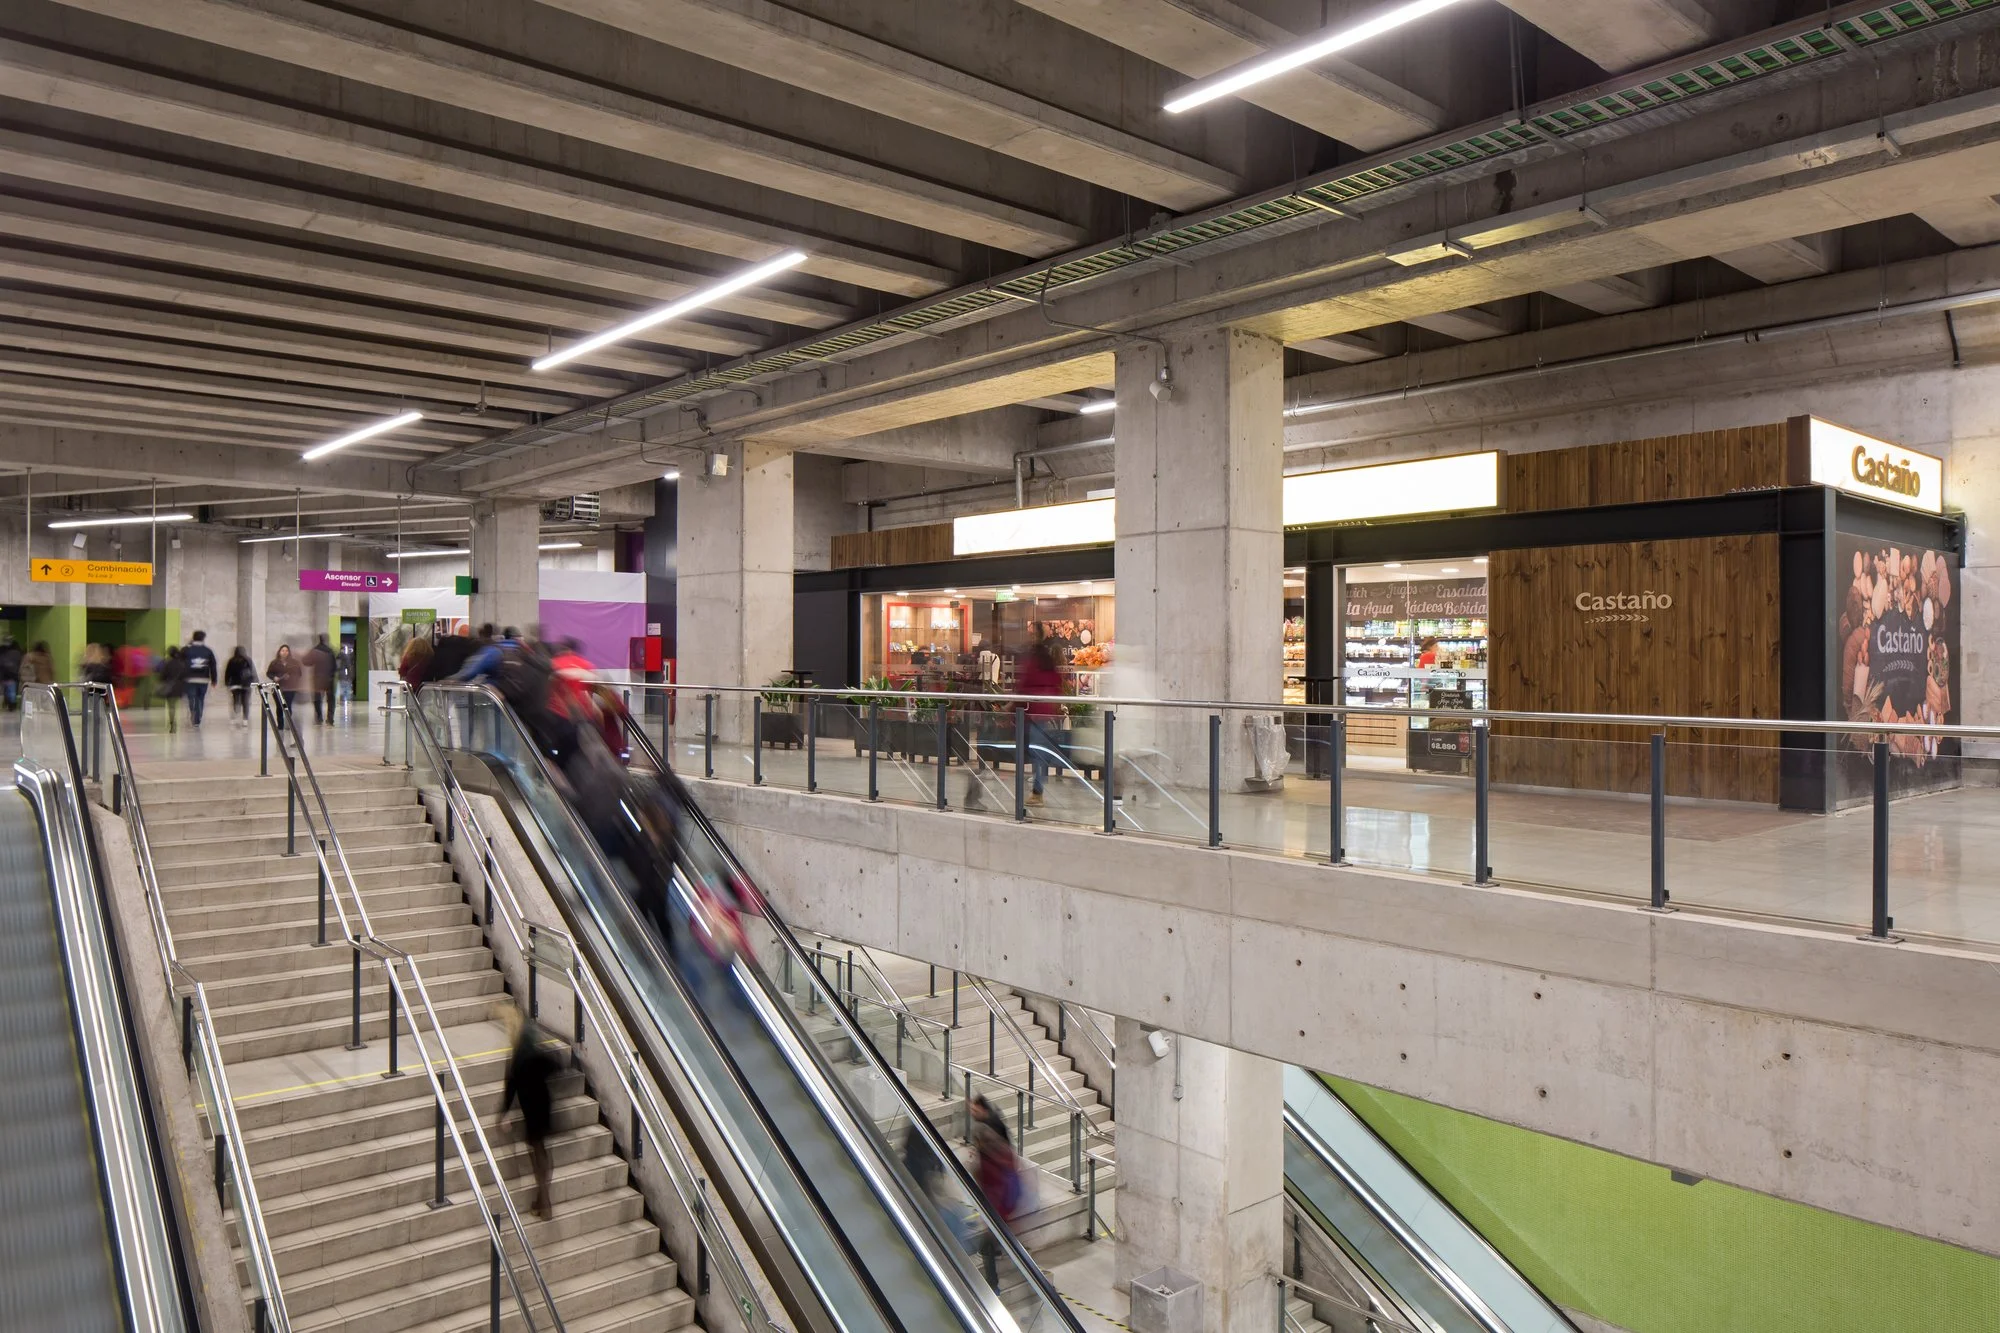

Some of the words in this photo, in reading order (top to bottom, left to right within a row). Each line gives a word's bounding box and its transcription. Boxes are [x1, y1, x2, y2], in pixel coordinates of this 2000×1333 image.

[1852, 445, 1920, 497] Castaño
[87, 564, 148, 574] Combinación
[325, 573, 361, 581] Ascensor
[1386, 583, 1418, 599] Jugos
[1361, 601, 1394, 618] Agua
[1404, 600, 1444, 617] Lácteos
[1575, 590, 1673, 611] Castaño
[1877, 624, 1924, 654] Castaño
